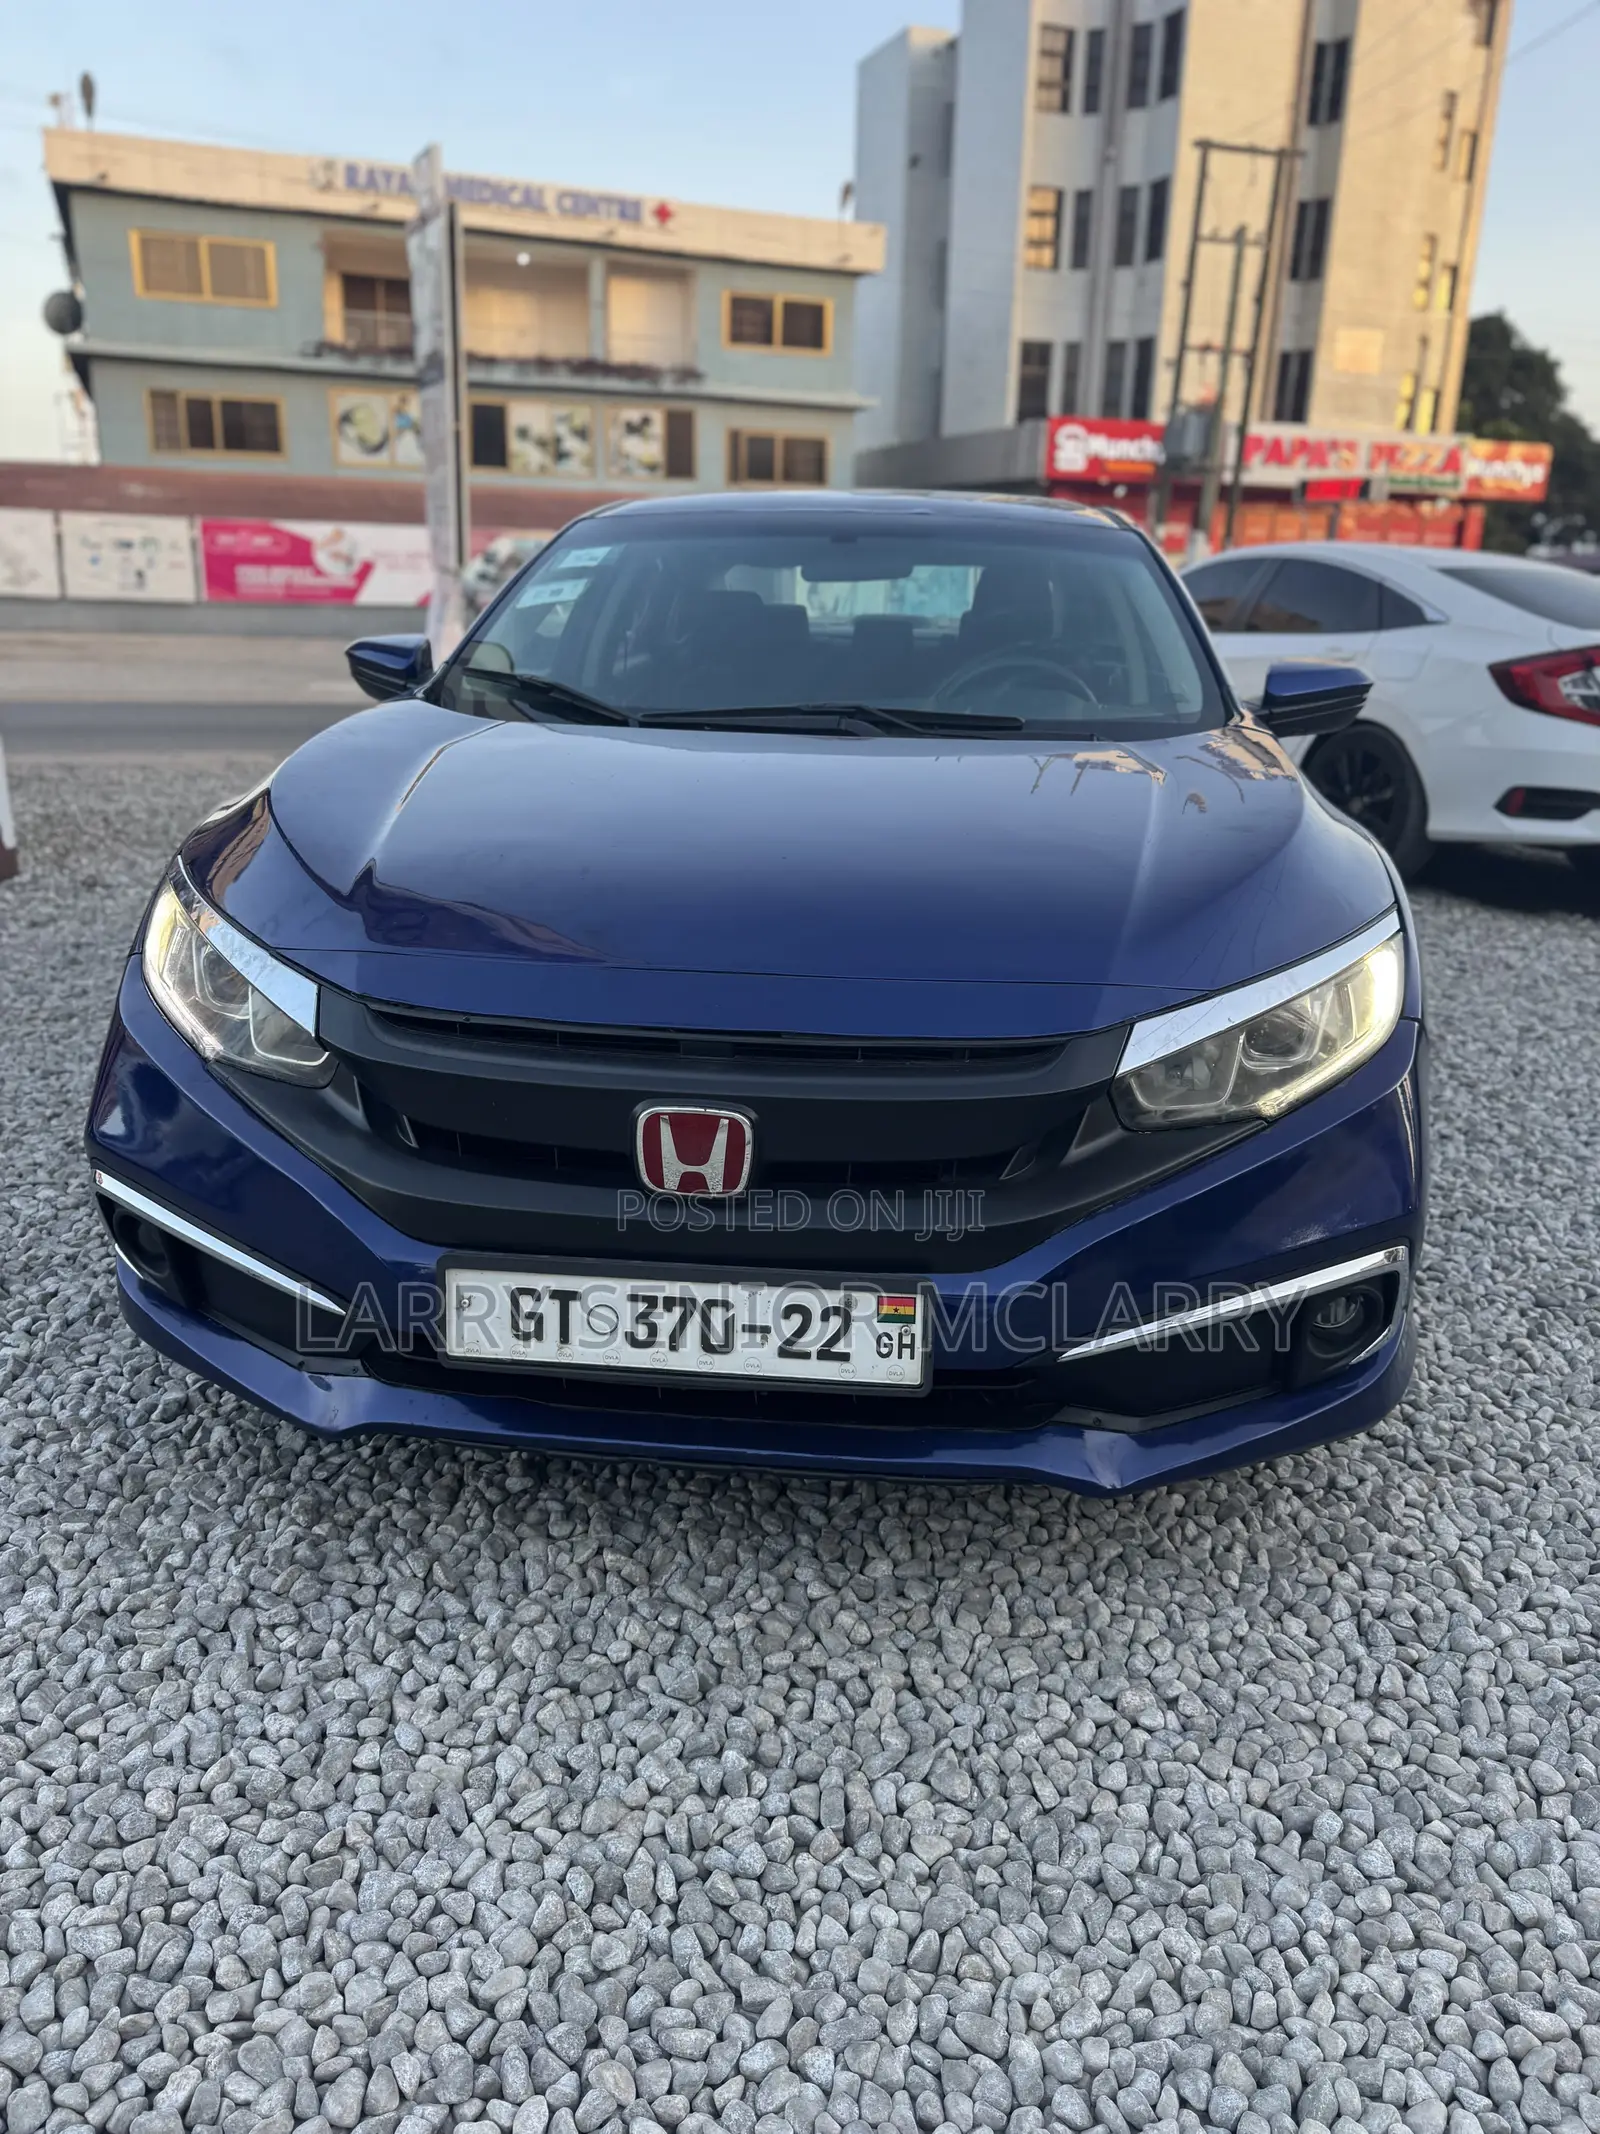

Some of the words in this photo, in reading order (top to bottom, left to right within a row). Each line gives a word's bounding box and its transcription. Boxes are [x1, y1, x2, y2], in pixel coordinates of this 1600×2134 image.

[344, 161, 414, 195] RAYA
[445, 175, 547, 212] MEDICAL
[557, 190, 644, 222] CENTRE
[509, 1286, 582, 1345] GT
[624, 1293, 852, 1362] 370-22
[875, 1331, 916, 1360] GH
